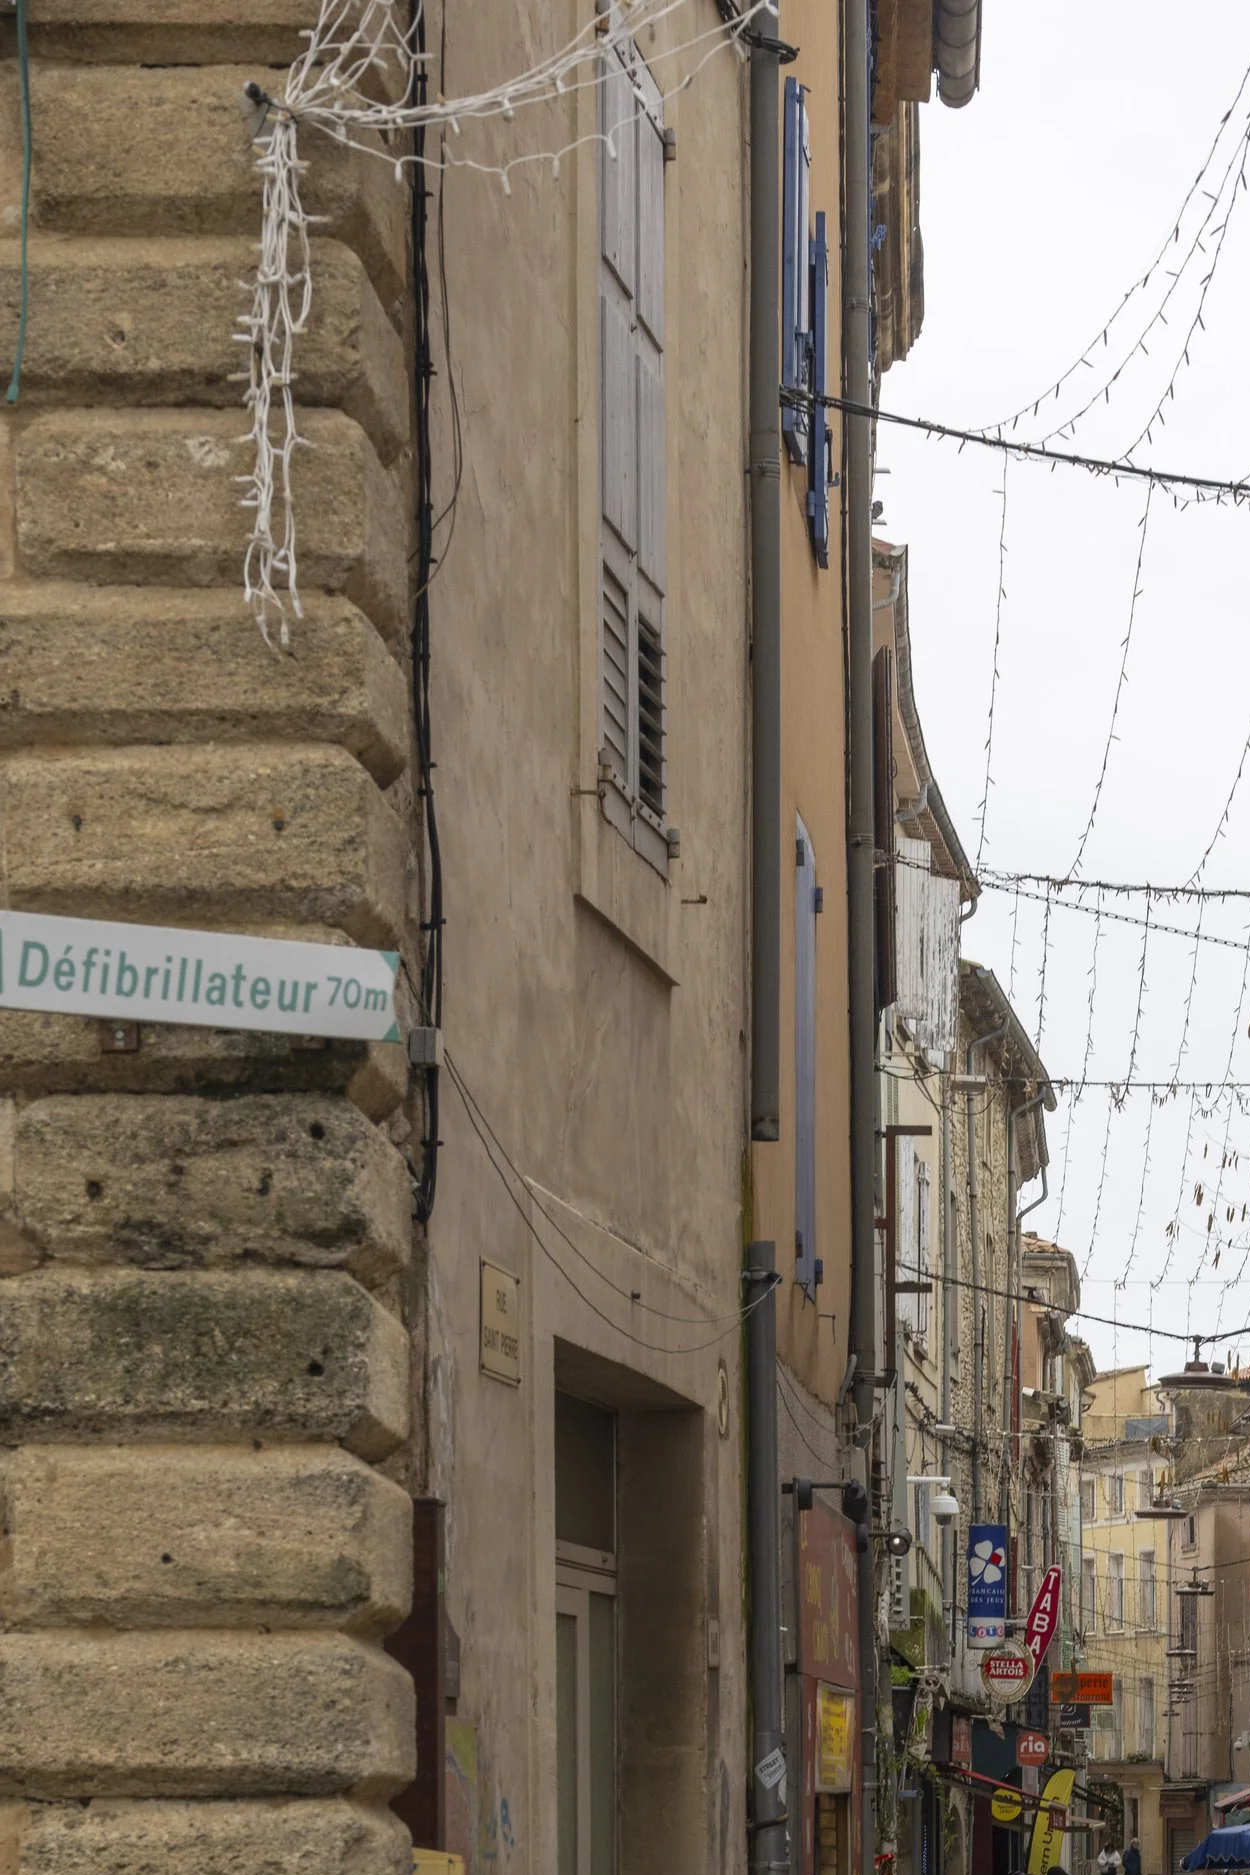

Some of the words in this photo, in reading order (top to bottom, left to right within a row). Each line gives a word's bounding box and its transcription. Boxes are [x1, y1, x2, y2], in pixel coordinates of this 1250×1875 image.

[17, 939, 319, 1013] Défibrillateur
[326, 976, 389, 1012] 70m
[496, 1288, 507, 1314] RUE
[1029, 1570, 1058, 1655] TABA
[969, 1625, 1004, 1638] LOTO
[989, 1668, 1024, 1676] ARTOIS
[990, 1660, 1024, 1668] STELLA
[1020, 1736, 1045, 1752] ria
